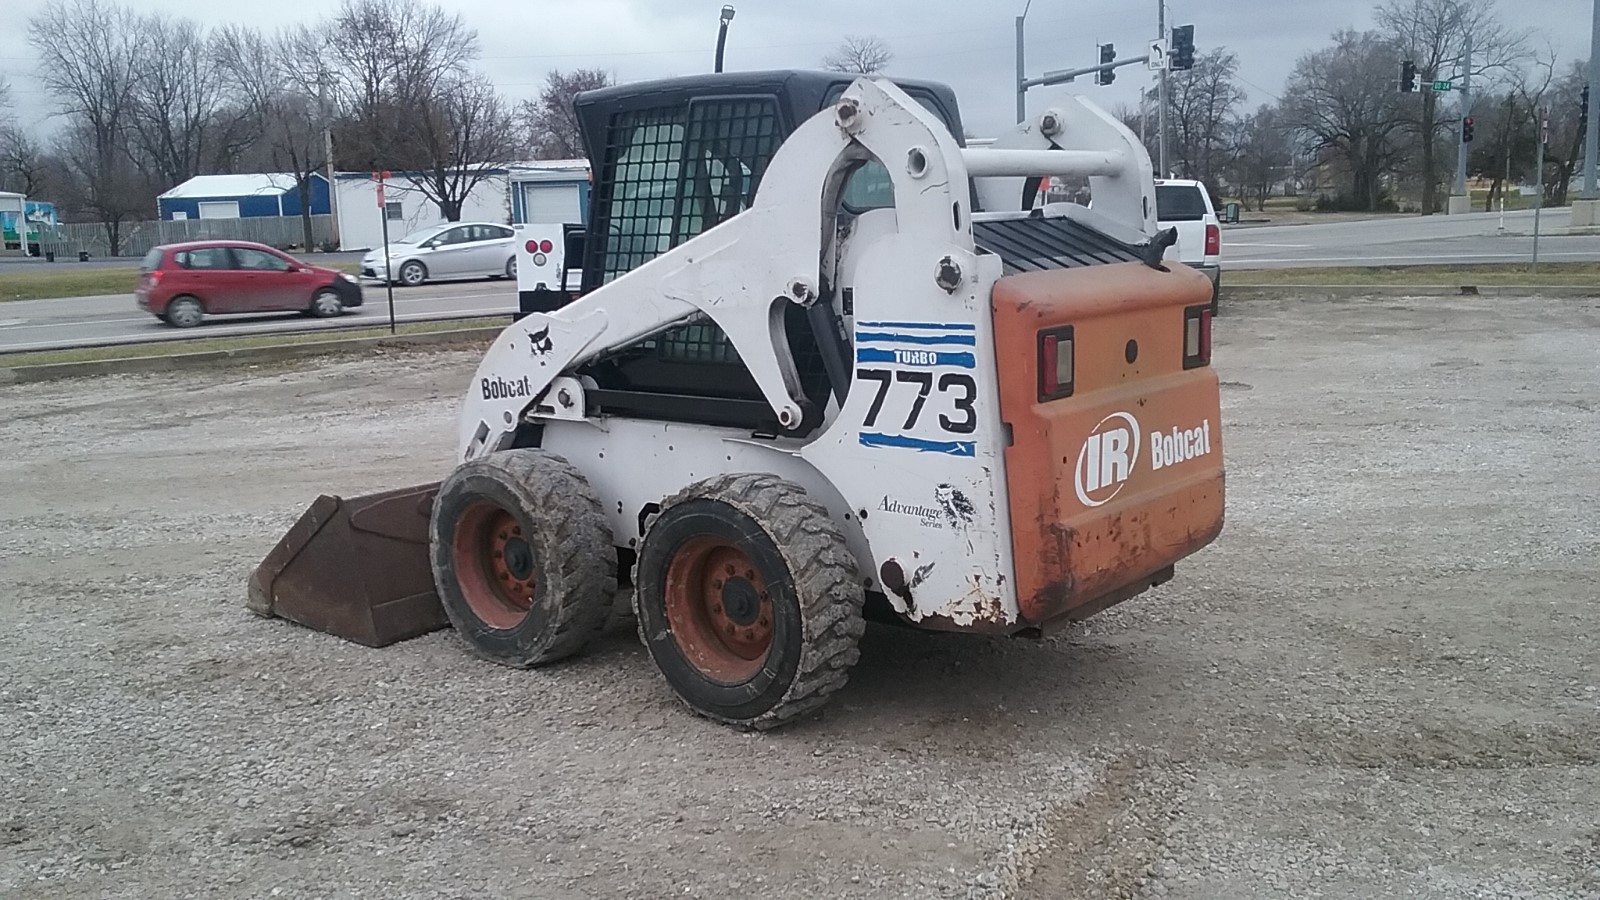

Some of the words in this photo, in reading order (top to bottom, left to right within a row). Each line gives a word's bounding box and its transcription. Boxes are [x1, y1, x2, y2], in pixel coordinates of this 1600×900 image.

[894, 351, 938, 365] TURBO
[481, 375, 531, 400] Bobcat
[857, 368, 977, 433] 773
[1151, 419, 1211, 470] Bobcat
[1087, 428, 1129, 492] IR
[877, 494, 943, 520] Advantage
[920, 518, 943, 529] Series
